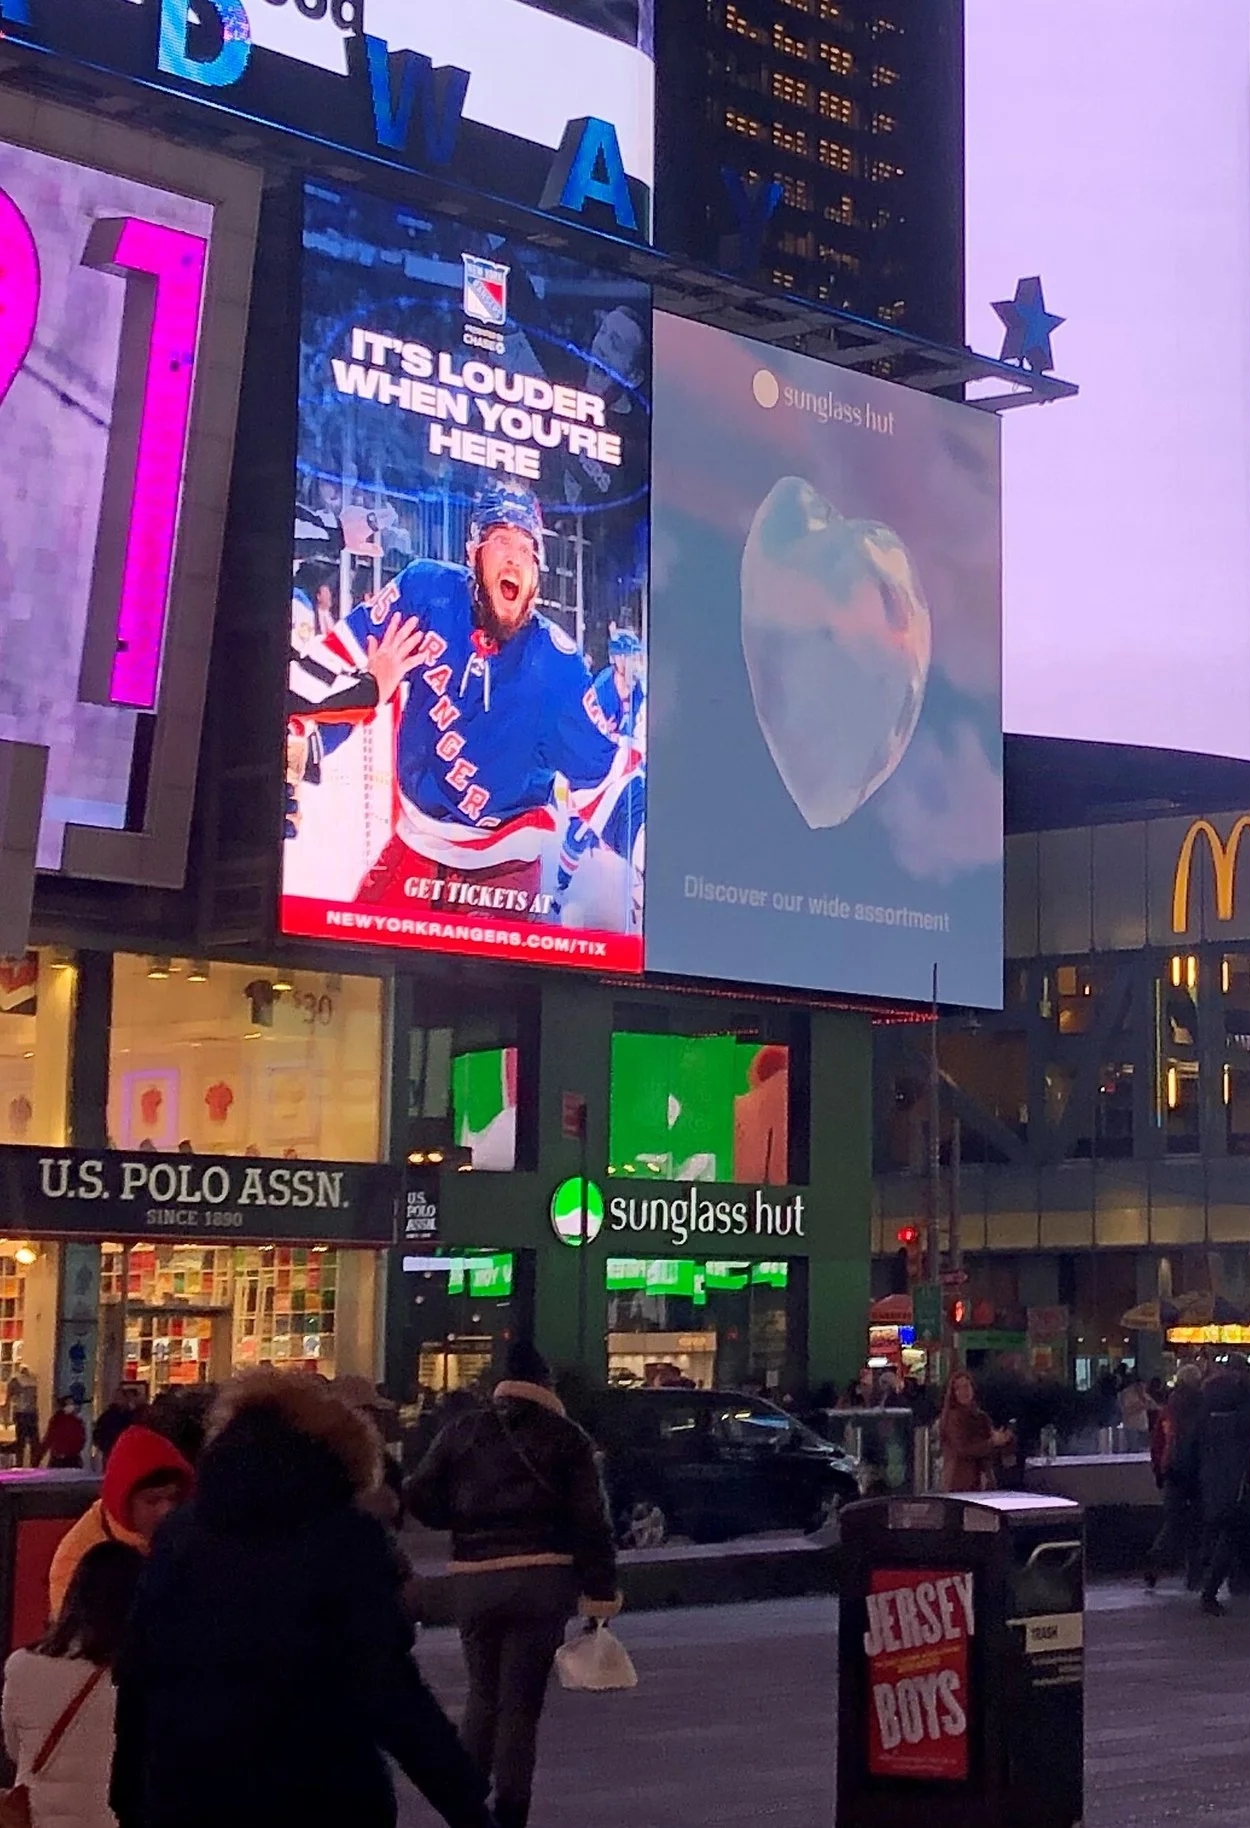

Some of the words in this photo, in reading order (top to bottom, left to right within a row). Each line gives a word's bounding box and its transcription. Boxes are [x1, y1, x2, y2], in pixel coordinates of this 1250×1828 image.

[352, 328, 436, 378] IT'S
[439, 351, 605, 427] LOUDER
[331, 359, 472, 425] WHEN
[474, 397, 622, 466] YOU'RE
[783, 386, 862, 426] sunglass
[865, 403, 896, 435] hut
[429, 423, 541, 480] HERE
[404, 877, 446, 903] GET
[448, 880, 529, 914] TICKETS
[530, 895, 553, 914] AT
[684, 874, 768, 907] Discover
[772, 891, 804, 912] our
[808, 895, 850, 919] wide
[854, 904, 950, 933] assortment
[326, 910, 607, 957] NEWYORKRANGERS.COM/TIX
[39, 1159, 109, 1199] U.S.
[120, 1163, 229, 1203] POLO
[237, 1168, 350, 1208] ASSN.
[406, 1205, 436, 1218] POLO
[147, 1209, 199, 1226] SINCE
[204, 1211, 244, 1228] 1890
[610, 1187, 747, 1246] sunglass
[755, 1190, 805, 1236] hut
[864, 1572, 975, 1658] JERSEY
[873, 1669, 967, 1750] BOYS
